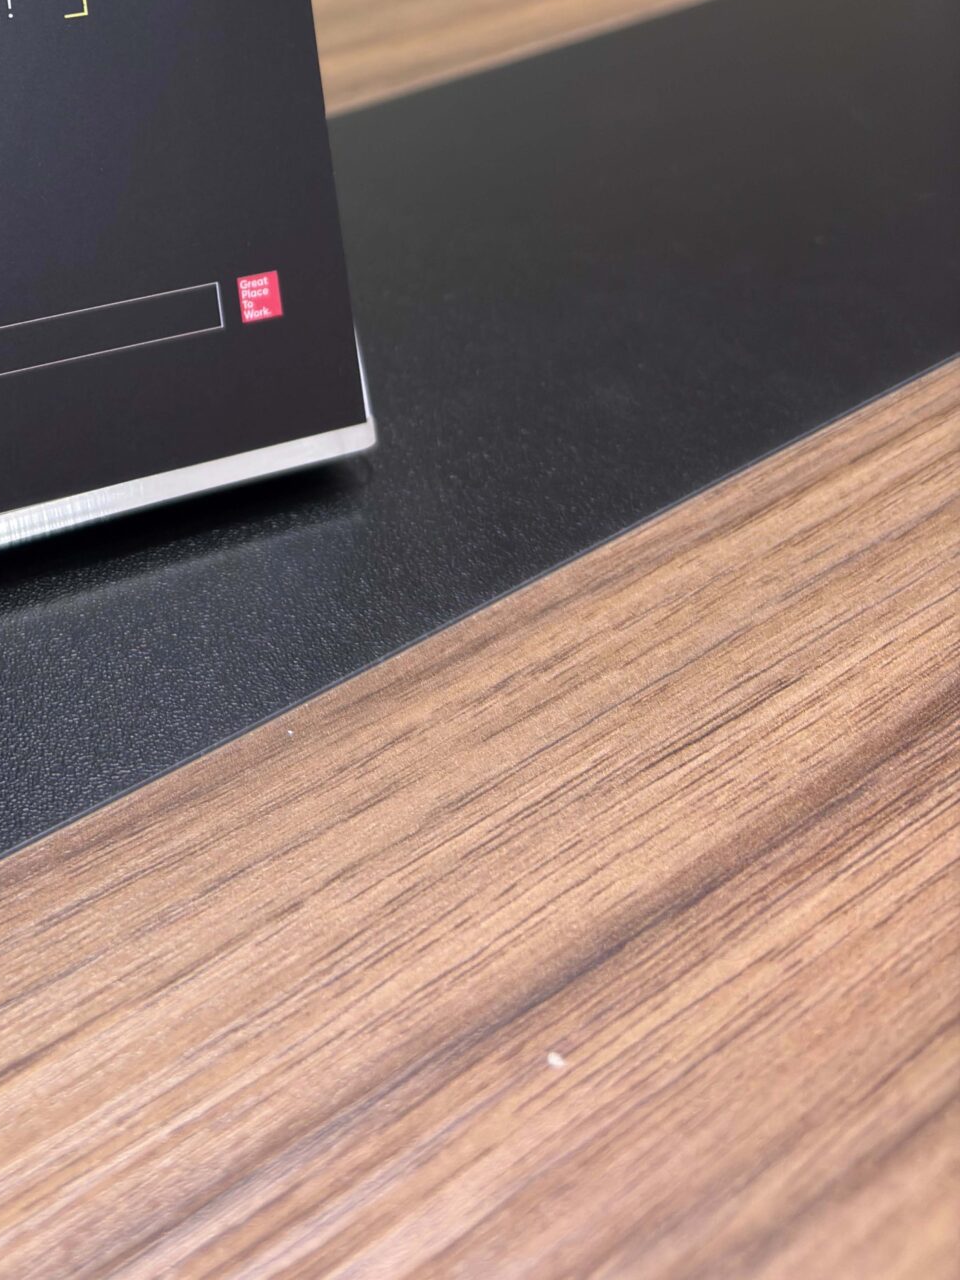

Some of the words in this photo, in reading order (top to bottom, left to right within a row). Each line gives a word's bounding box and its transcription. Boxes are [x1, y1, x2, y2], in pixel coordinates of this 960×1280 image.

[240, 276, 268, 289] Great
[241, 287, 269, 299] Place
[242, 299, 254, 310] To
